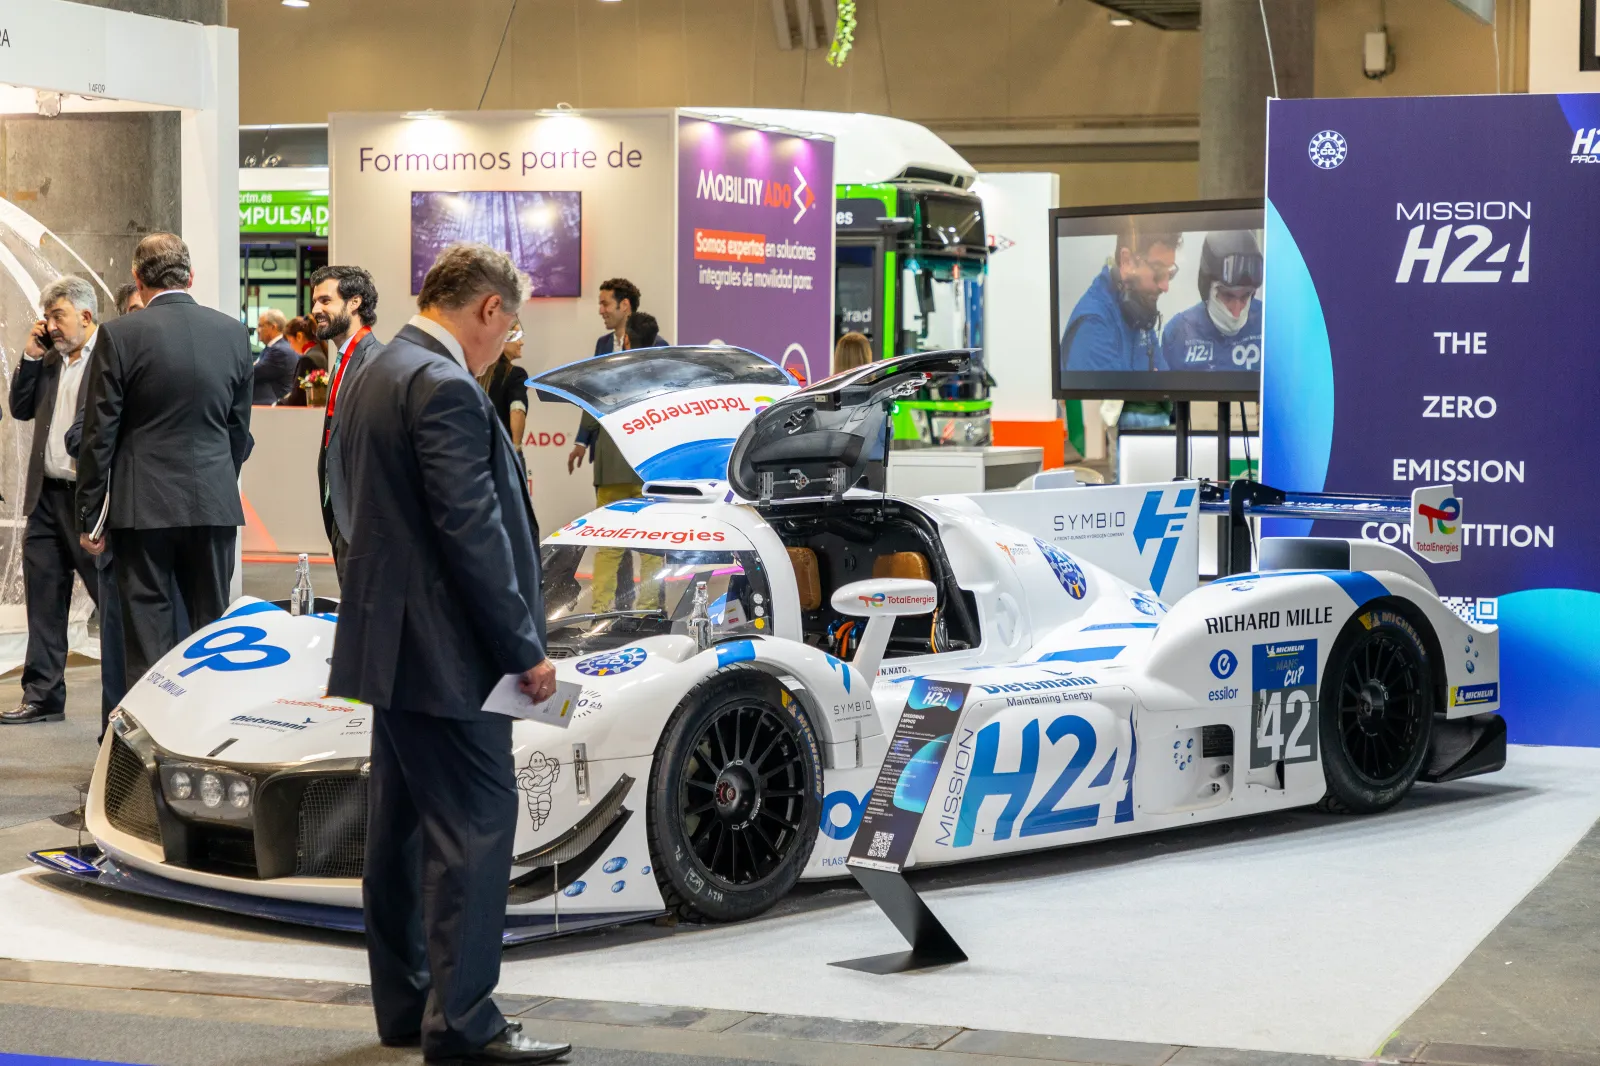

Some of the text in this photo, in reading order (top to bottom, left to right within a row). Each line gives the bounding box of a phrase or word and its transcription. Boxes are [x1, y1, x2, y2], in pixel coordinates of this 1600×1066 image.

[359, 141, 643, 176] Formamos parte de
[696, 169, 792, 209] MOBILITY ADO
[1396, 201, 1531, 221] MISSION
[696, 231, 816, 261] Somos expertos en soluciones
[1395, 224, 1531, 283] H24
[699, 264, 741, 291] integrales
[742, 266, 753, 287] de
[754, 267, 793, 289] movilidad
[1433, 332, 1488, 354] THE
[622, 396, 750, 435] TotalEnergies
[1422, 396, 1498, 418] ZERO
[525, 432, 566, 447] ADO
[1393, 458, 1525, 483] EMISSION
[1053, 511, 1126, 532] SYMBIO
[576, 525, 725, 544] TotalEnergies
[1416, 541, 1459, 554] TotalEnergies
[887, 595, 935, 606] TotalEnergies
[1205, 606, 1333, 635] RICHARD MILLE
[1276, 644, 1305, 653] MICHELIN
[881, 666, 907, 676] N.NATO
[1284, 665, 1305, 687] CUP
[979, 676, 1098, 695] Dietsmann
[1208, 686, 1239, 701] essilor
[1465, 689, 1494, 700] MICHELIN
[833, 700, 872, 715] SYMBIO
[922, 691, 951, 707] H24
[1006, 691, 1093, 707] Maintaining Energy
[230, 715, 307, 731] Dietsmann
[1255, 689, 1312, 761] 42
[797, 712, 822, 796] MICHELIN
[952, 704, 1137, 848] H24
[935, 728, 974, 846] MISSION
